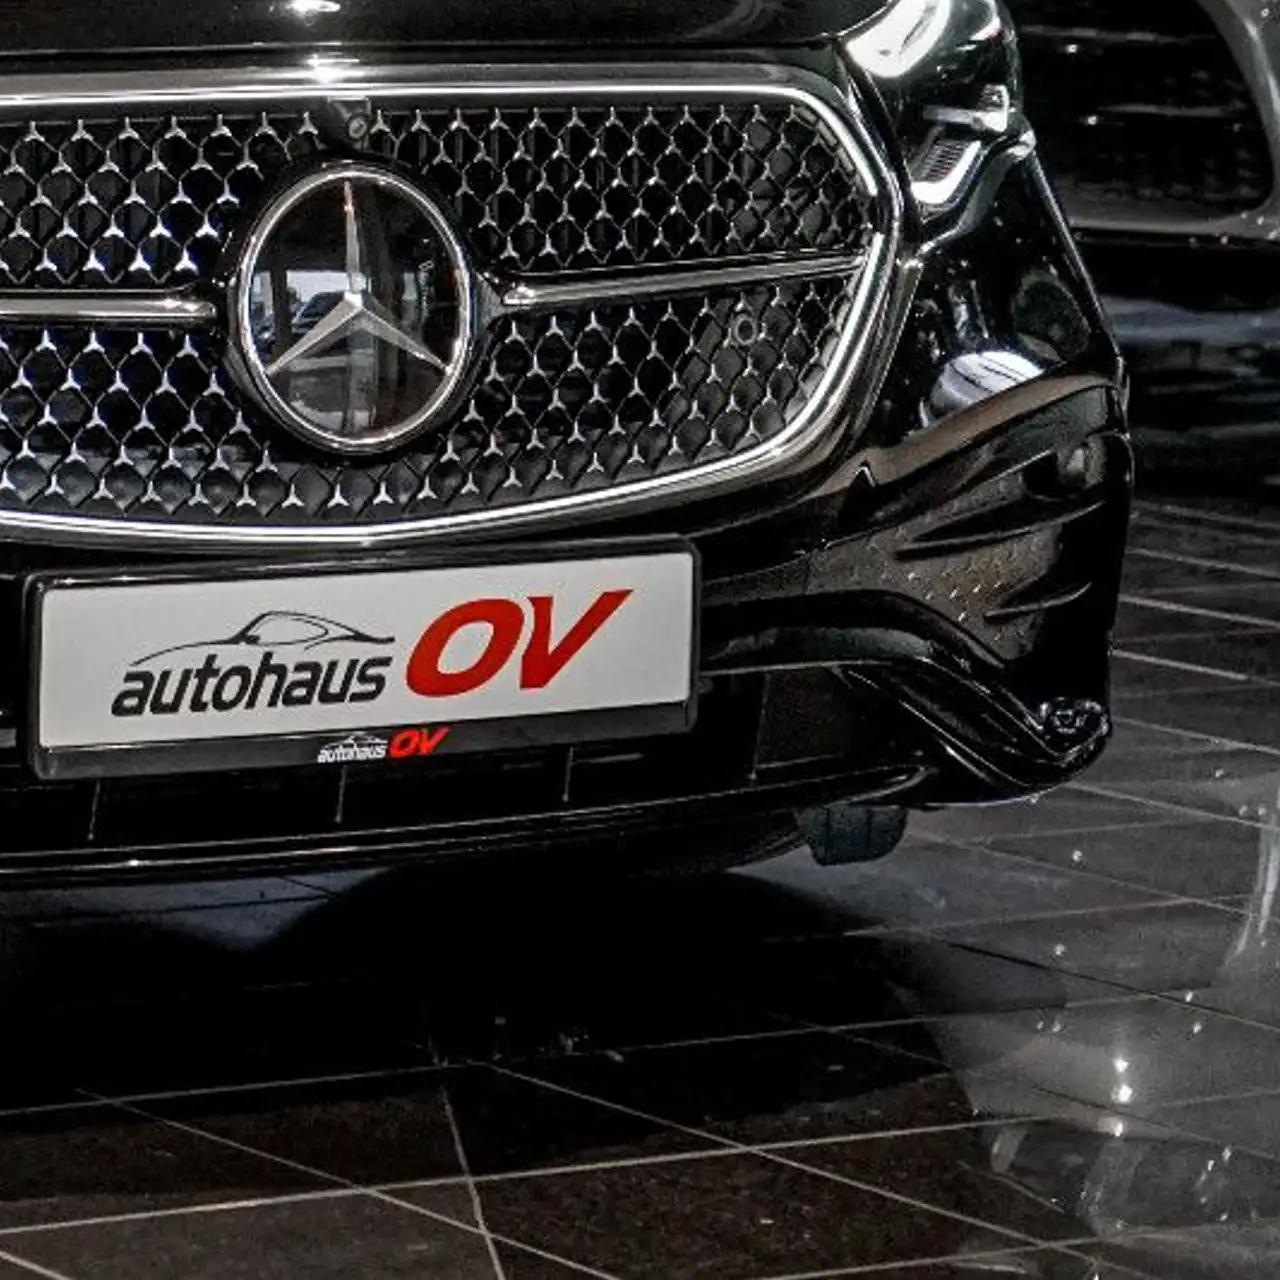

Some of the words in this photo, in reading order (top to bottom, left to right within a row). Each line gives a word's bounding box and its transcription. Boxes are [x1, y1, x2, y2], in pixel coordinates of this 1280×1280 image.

[111, 651, 392, 717] autohaus
[406, 589, 633, 698] OV
[317, 743, 387, 763] autohaus
[389, 726, 449, 758] OV
